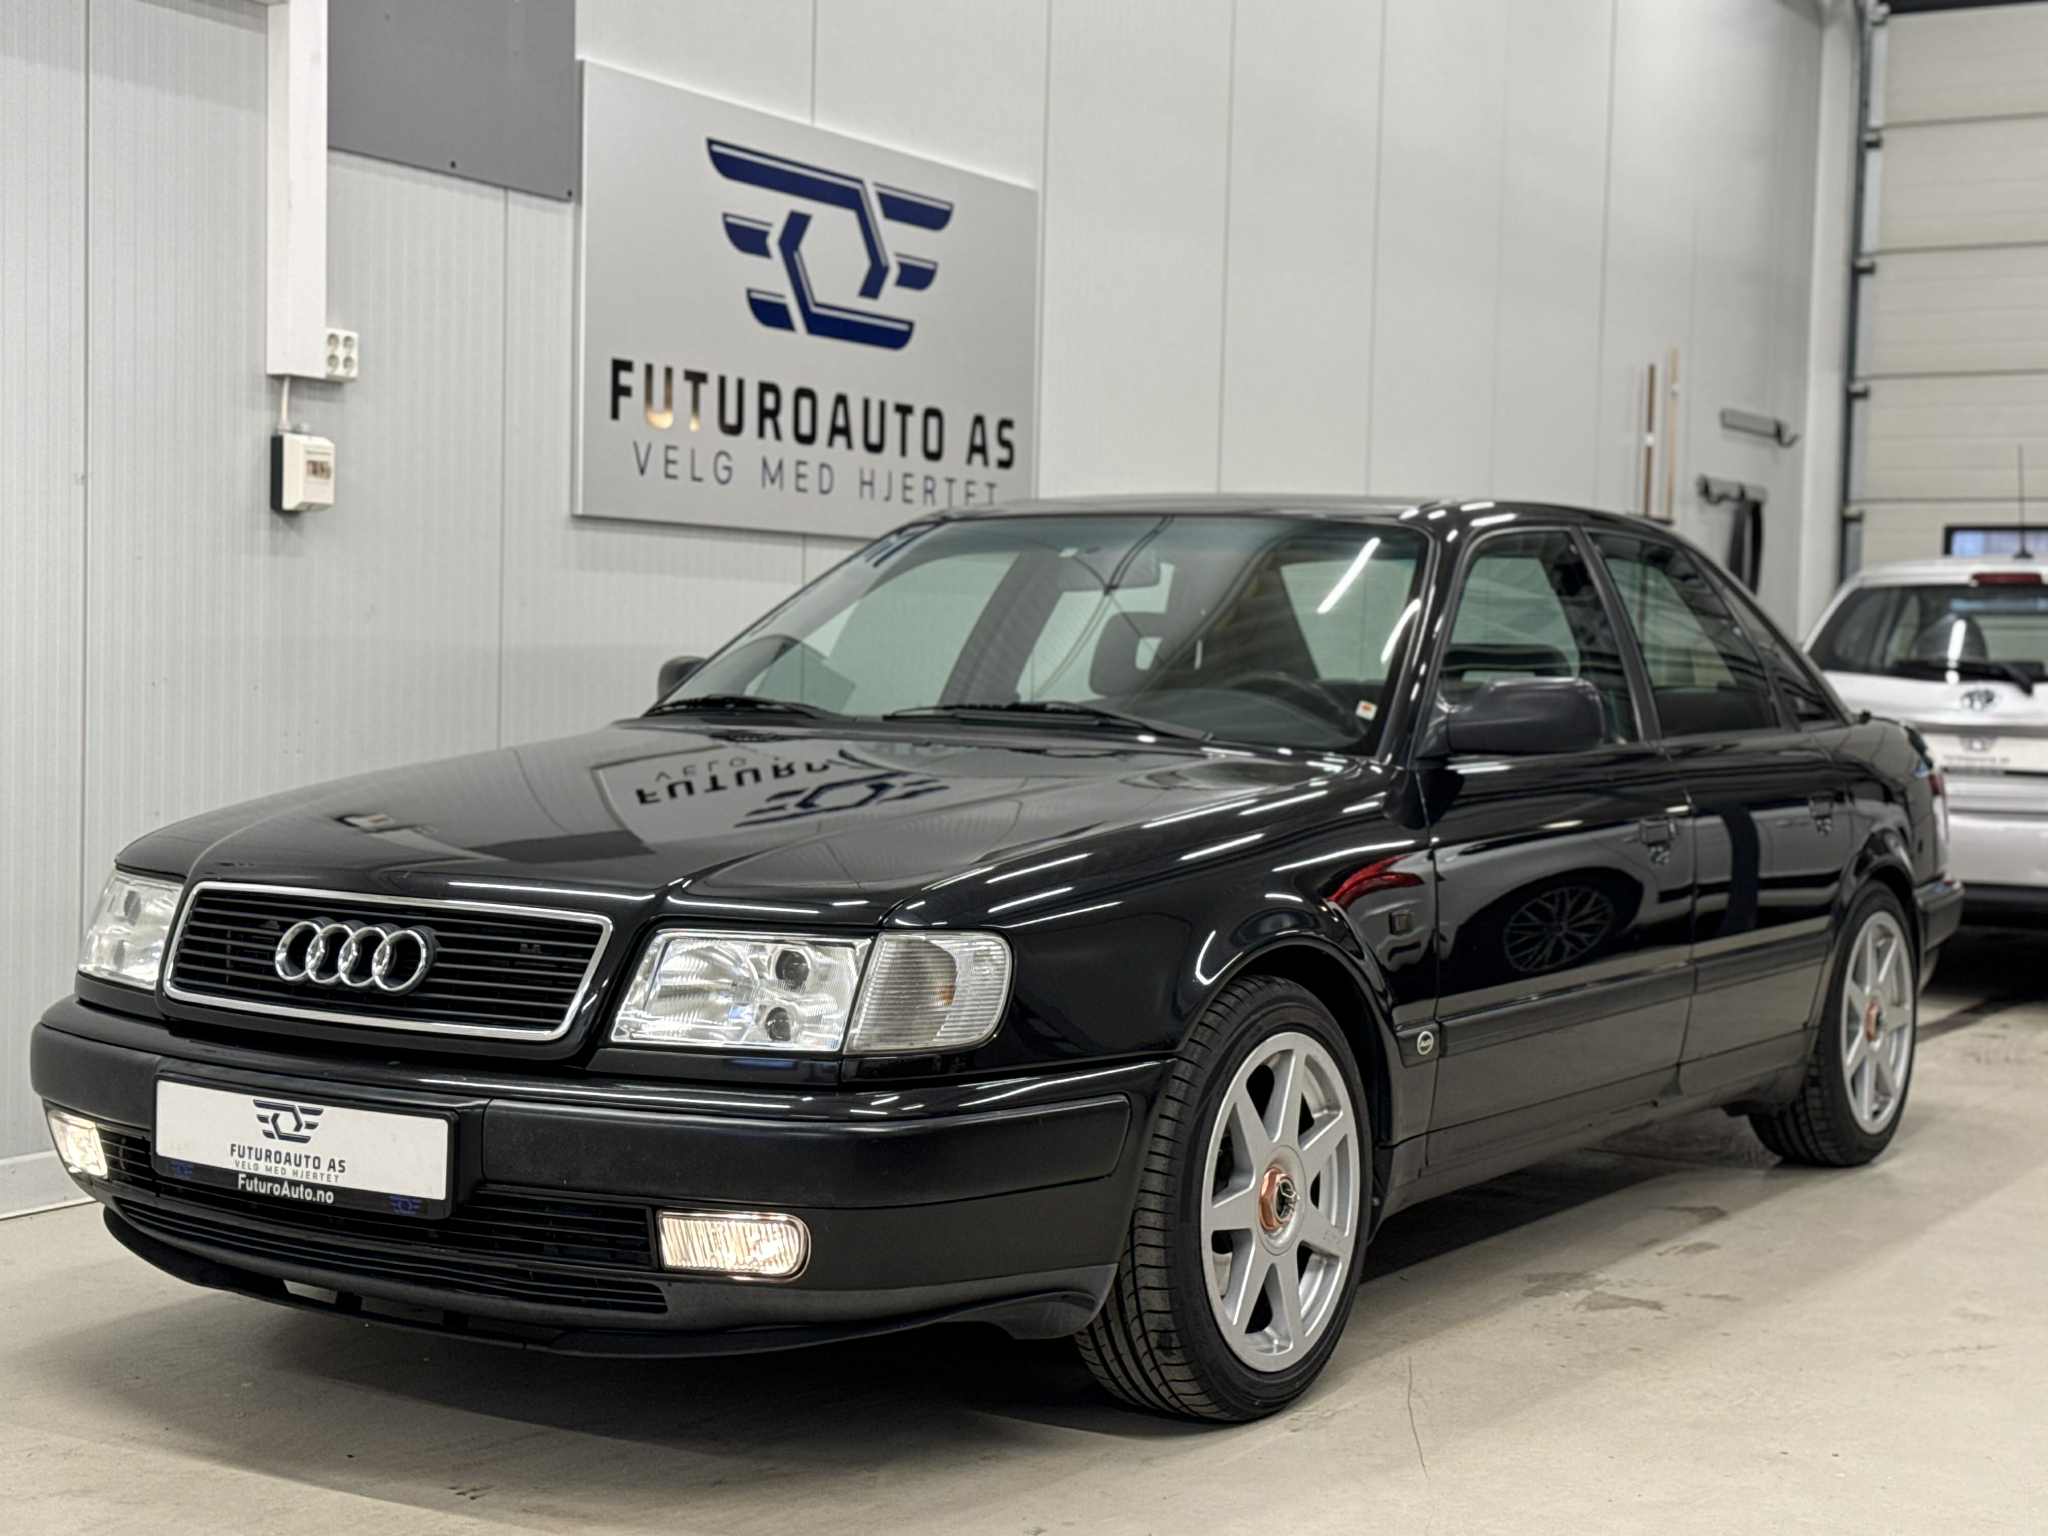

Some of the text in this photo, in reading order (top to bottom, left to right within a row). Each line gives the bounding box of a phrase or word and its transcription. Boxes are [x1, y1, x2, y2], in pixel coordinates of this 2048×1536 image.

[610, 357, 1015, 470] FUTUROAUTO AS
[633, 440, 733, 485] VELG
[761, 457, 835, 495] MED
[230, 1143, 346, 1174] FUTUROAUTO AS
[234, 1159, 340, 1184] VELG MED HJERTET
[237, 1173, 334, 1204] FuturoAuto.no
